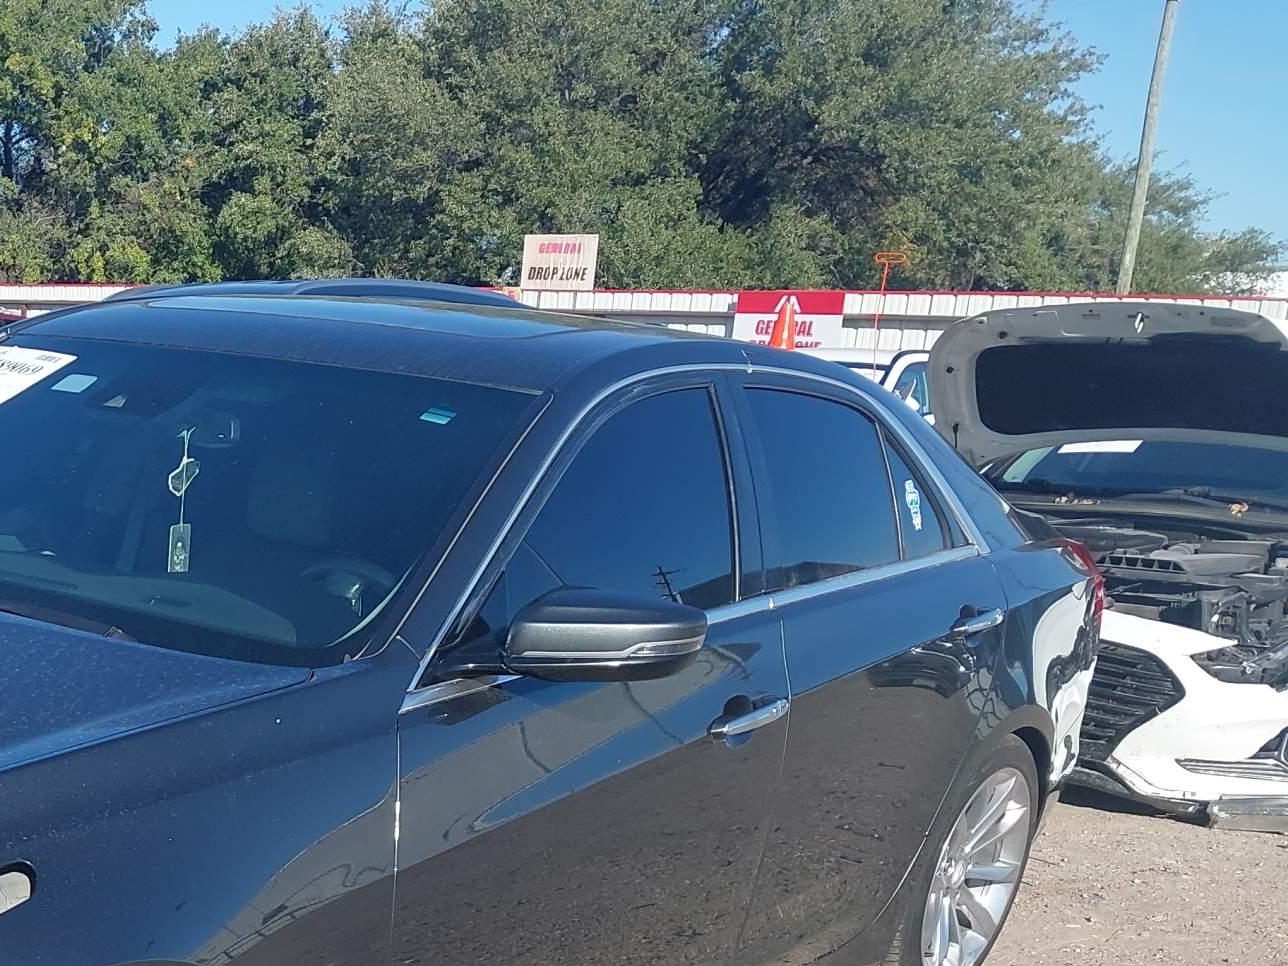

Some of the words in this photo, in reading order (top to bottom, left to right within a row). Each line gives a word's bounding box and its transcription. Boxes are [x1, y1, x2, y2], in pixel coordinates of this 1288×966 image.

[527, 266, 558, 281] DROP
[559, 266, 588, 281] ZONE
[755, 319, 813, 337] GEAL
